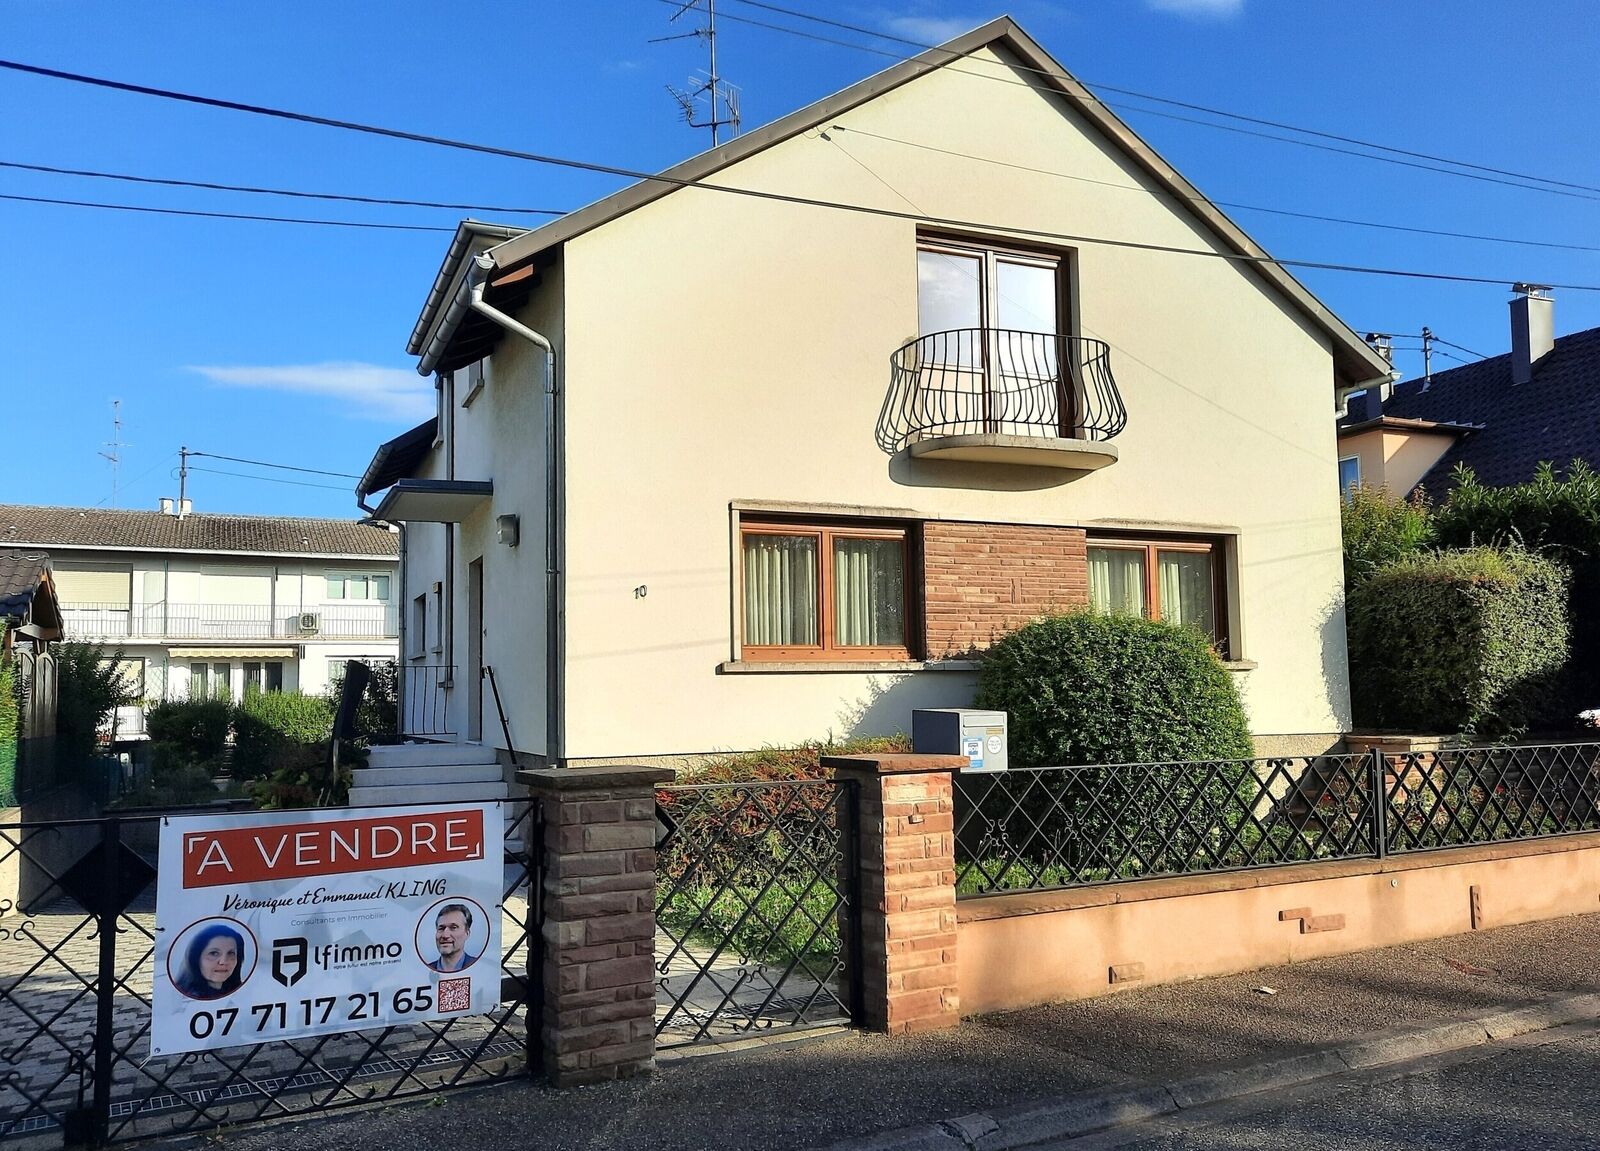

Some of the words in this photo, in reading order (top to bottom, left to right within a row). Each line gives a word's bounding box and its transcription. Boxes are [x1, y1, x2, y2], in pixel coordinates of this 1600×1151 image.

[197, 840, 233, 875] A
[254, 819, 469, 869] VENDRE
[223, 894, 294, 913] Véronique
[297, 890, 312, 905] et
[313, 884, 385, 905] Emmanuel
[385, 879, 447, 899] KLING
[290, 917, 335, 926] Consultants
[348, 912, 388, 921] Immobilier
[189, 1007, 239, 1039] 07
[251, 1002, 286, 1032] 71
[300, 996, 336, 1026] 17
[347, 991, 380, 1020] 21
[393, 985, 433, 1014] 65
